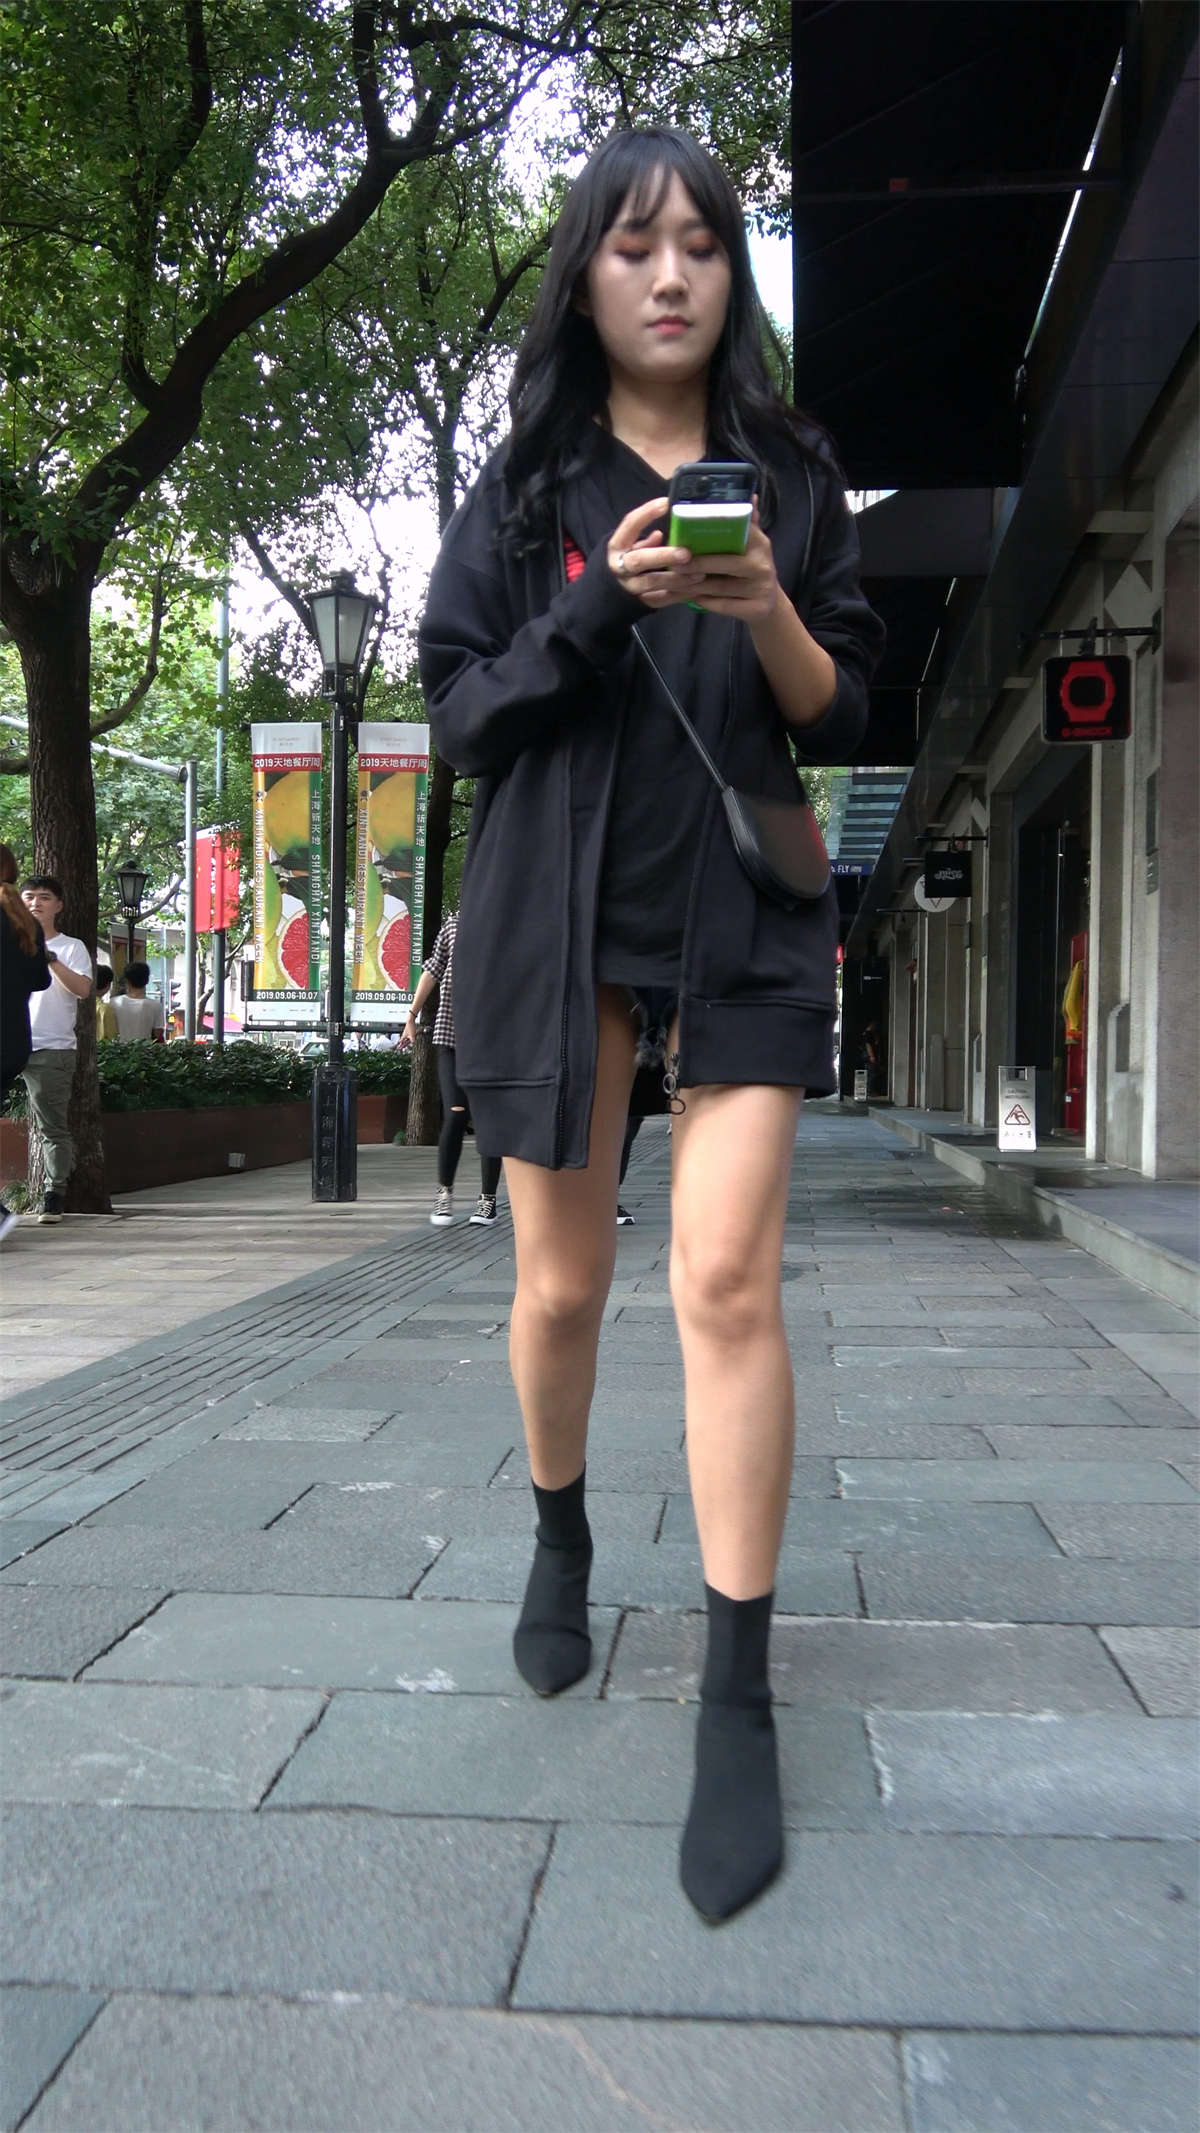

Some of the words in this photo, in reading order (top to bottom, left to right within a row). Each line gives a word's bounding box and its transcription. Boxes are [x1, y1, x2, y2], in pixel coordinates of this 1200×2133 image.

[254, 757, 321, 769] 2019天地餐厅周
[360, 758, 428, 769] 2019天地餐厅周
[255, 808, 265, 860] XINTIANDI
[311, 790, 321, 846] 上海新天地
[357, 808, 367, 860] XINTIANDI
[415, 792, 425, 847] 上海新天地
[254, 863, 265, 929] RESTAURANT
[311, 854, 321, 907] SHANGHAI
[356, 863, 366, 929] RESTAURANT
[413, 856, 424, 908] SHANGHAI
[254, 933, 265, 963] WEEK
[311, 911, 320, 964] XINTIANDI
[355, 933, 365, 964] WEEK
[412, 913, 423, 966] XINTIANDI
